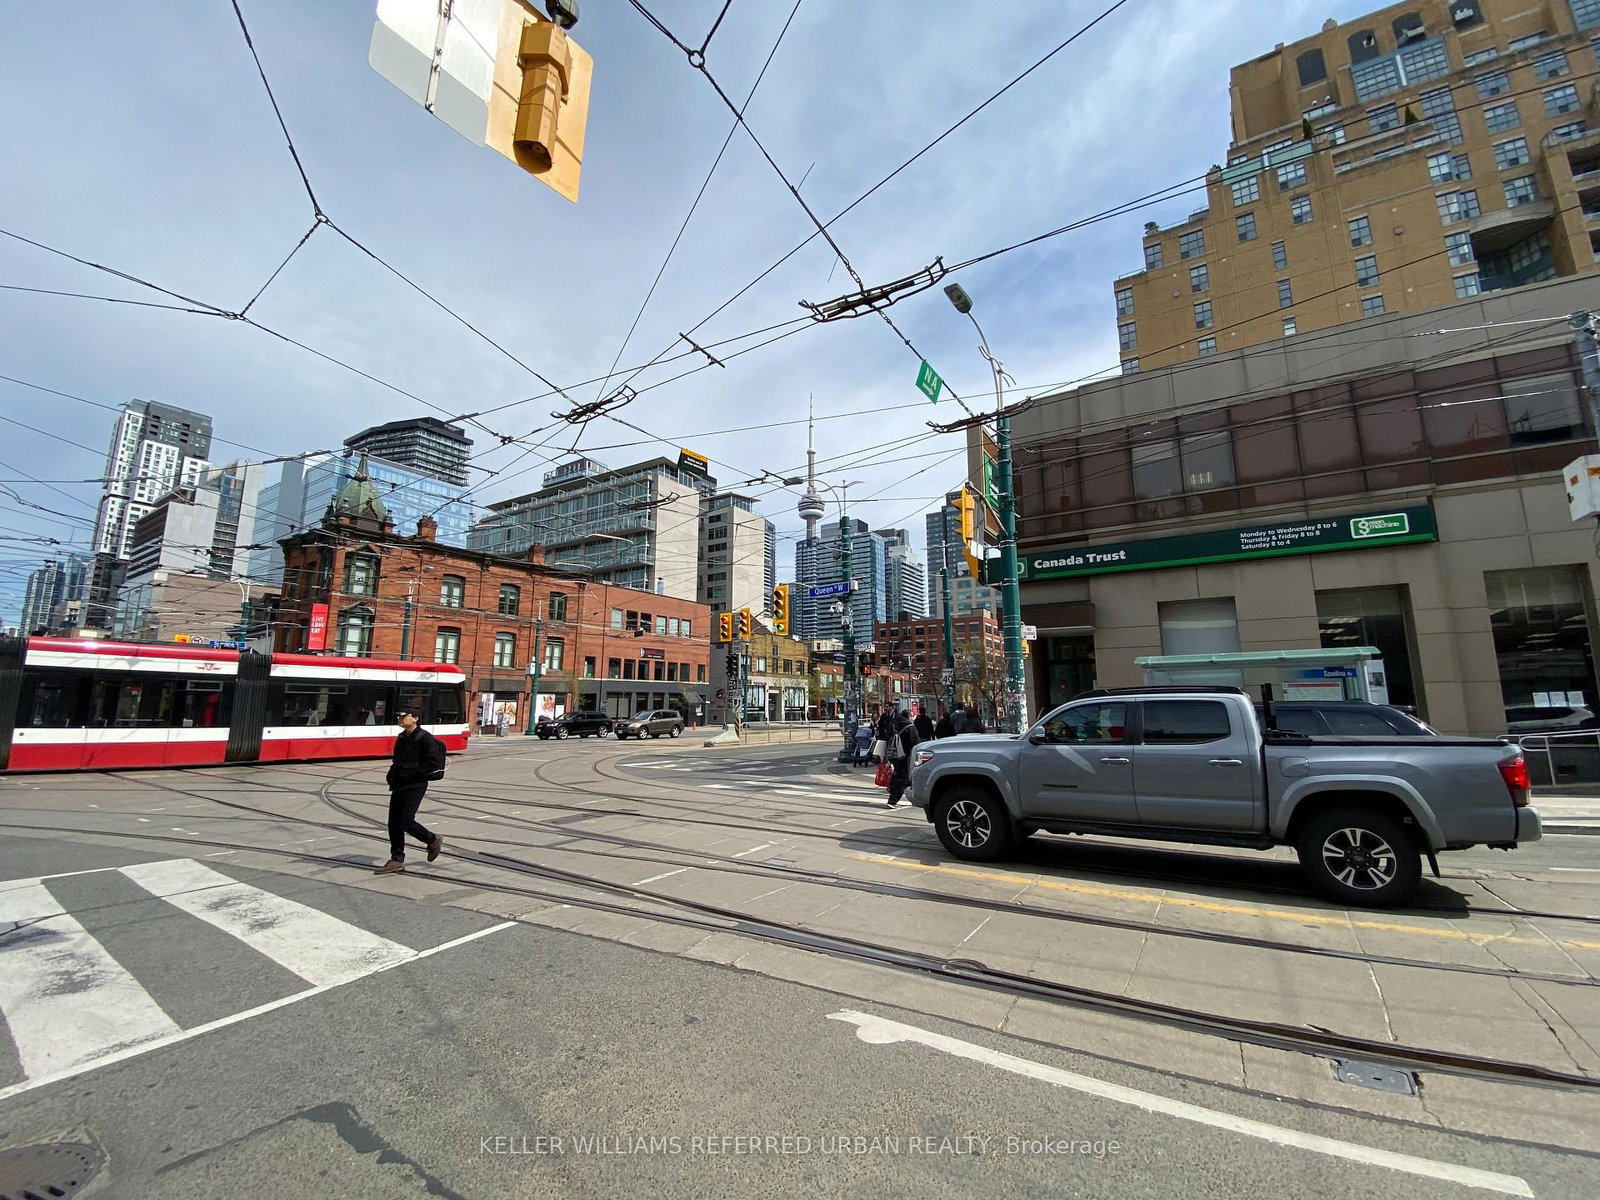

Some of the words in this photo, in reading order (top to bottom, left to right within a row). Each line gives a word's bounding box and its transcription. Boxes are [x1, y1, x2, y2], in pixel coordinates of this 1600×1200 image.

[1276, 524, 1316, 534] Wednesday
[1240, 536, 1270, 544] Thursday
[1241, 542, 1270, 550] Saturday
[1034, 556, 1084, 568] Canada
[1086, 550, 1126, 563] Trust
[814, 587, 834, 596] Queen
[838, 584, 844, 592] W
[943, 675, 954, 686] 40
